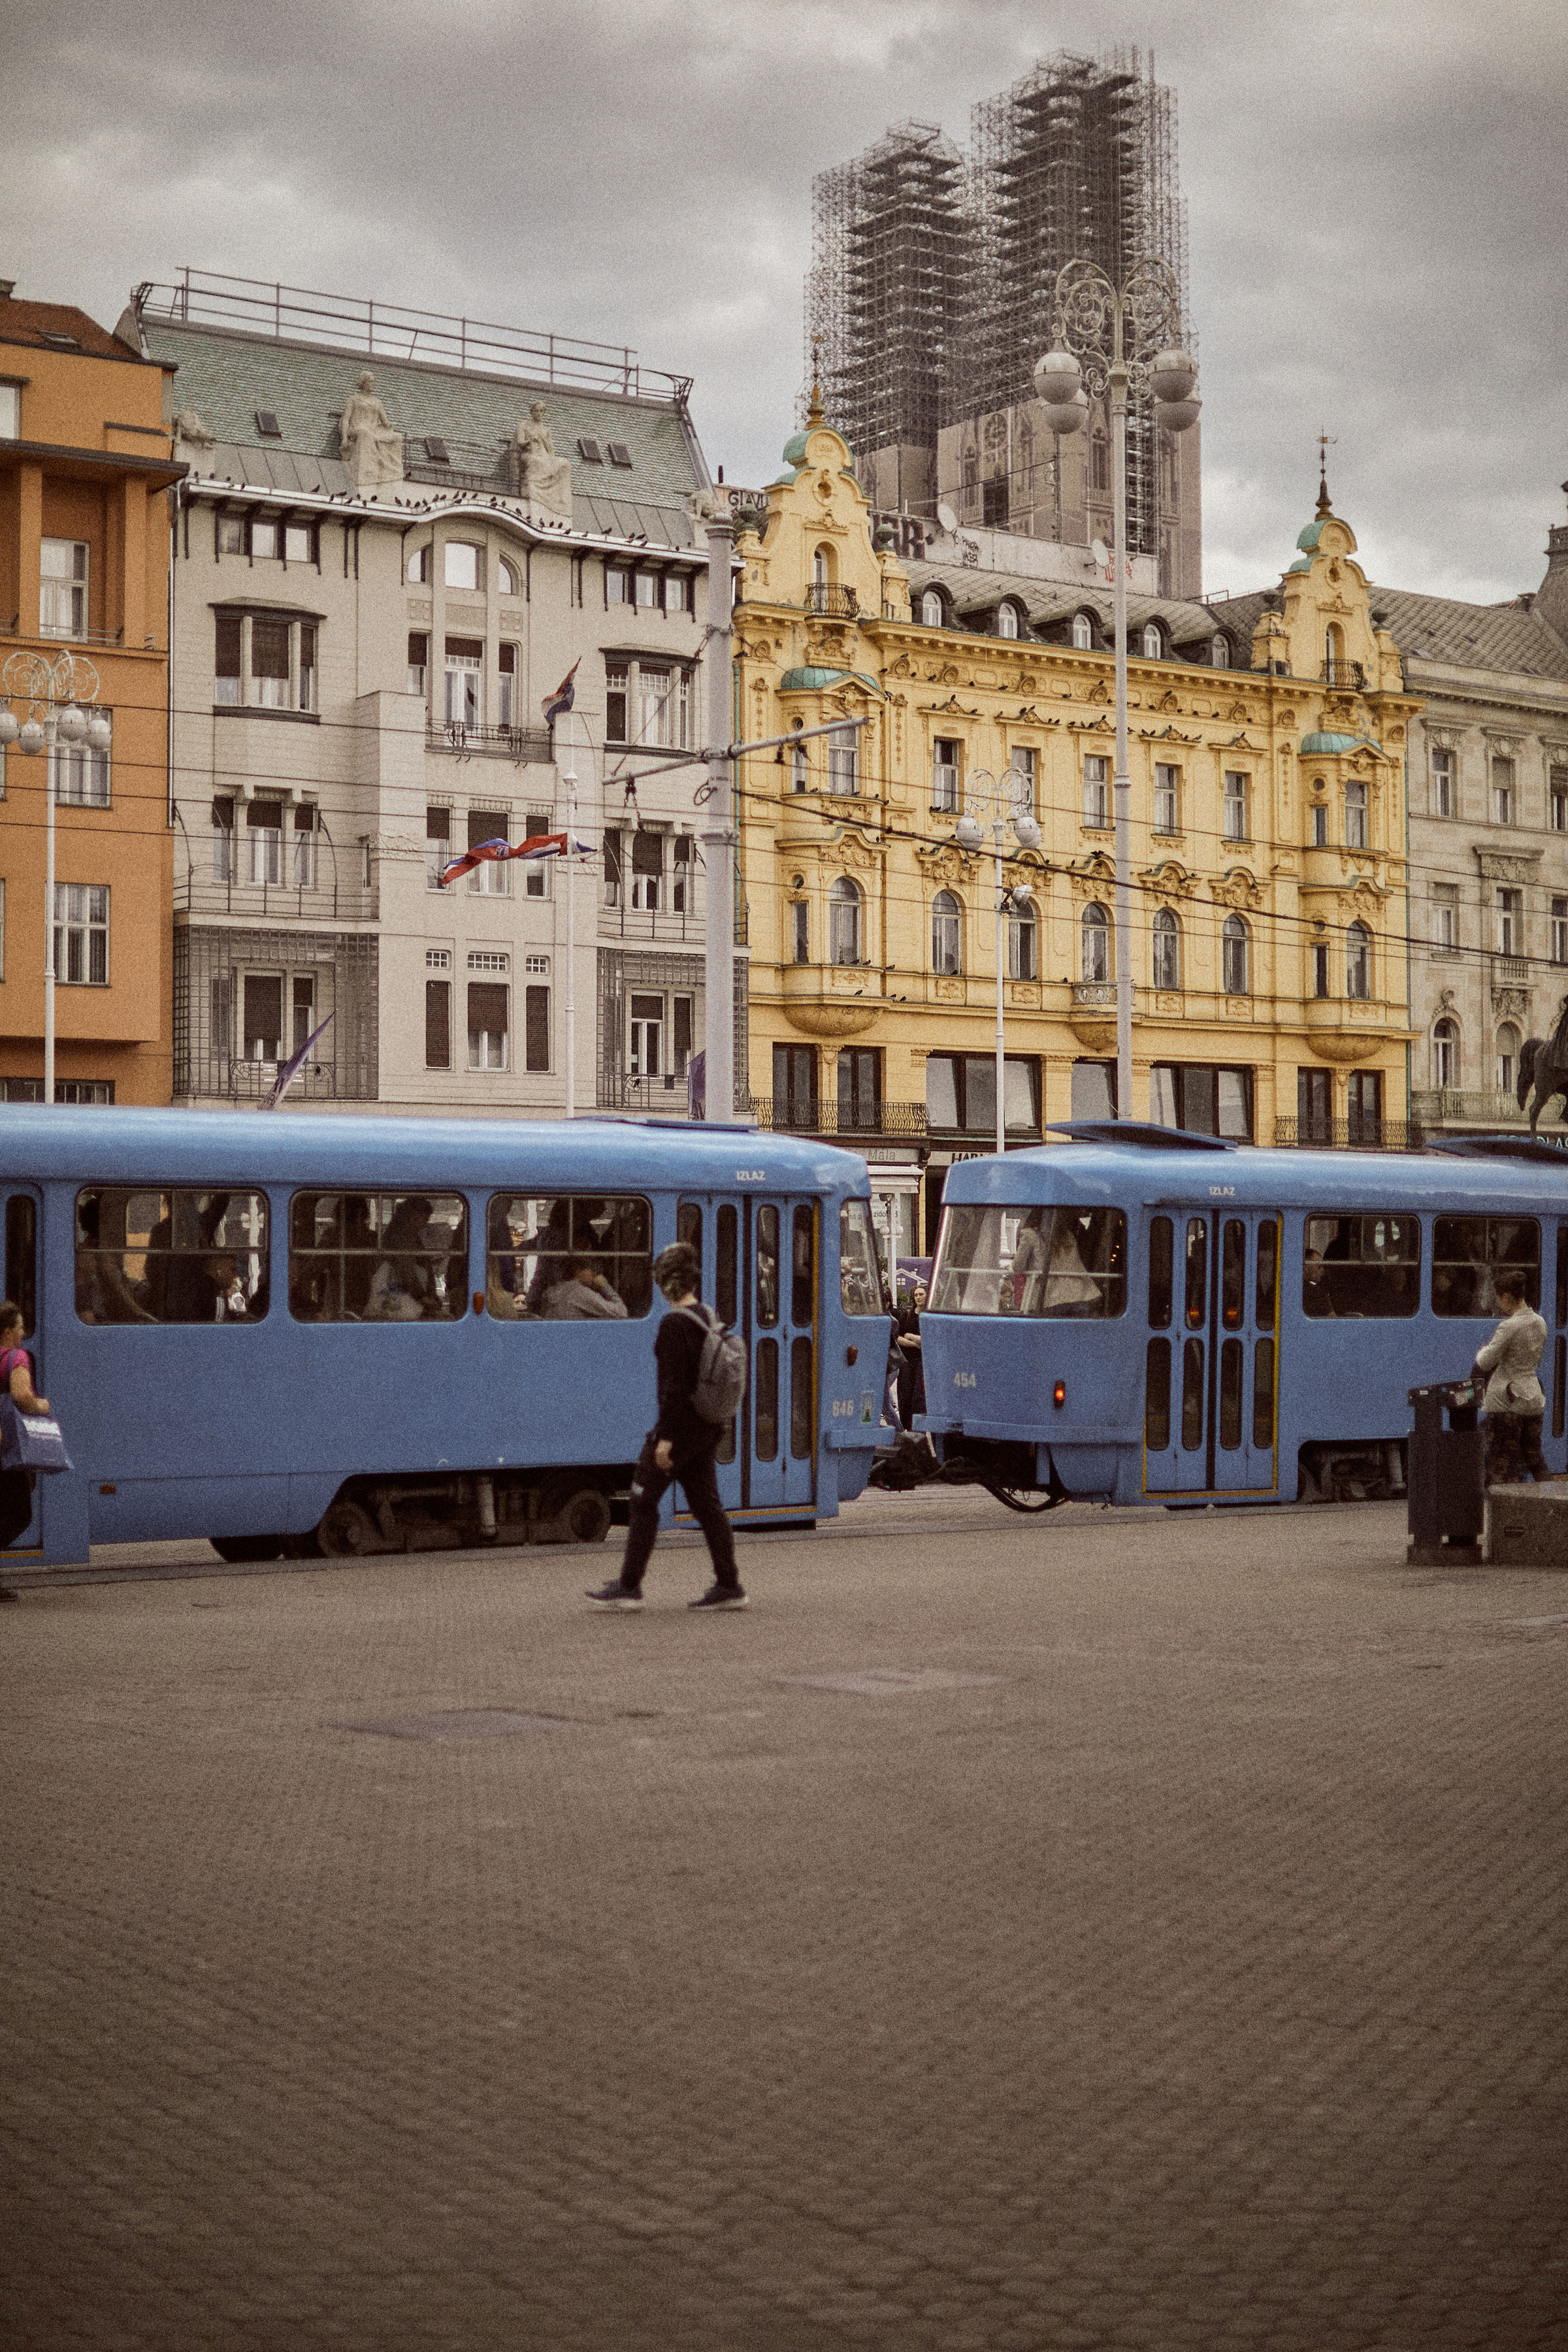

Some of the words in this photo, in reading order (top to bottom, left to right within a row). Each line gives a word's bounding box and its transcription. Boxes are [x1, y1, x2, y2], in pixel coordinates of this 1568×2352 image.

[868, 1149, 896, 1160] Mala
[736, 1170, 766, 1181] IZLAZ
[1209, 1186, 1236, 1196] IZLAZ
[953, 1372, 977, 1387] 454
